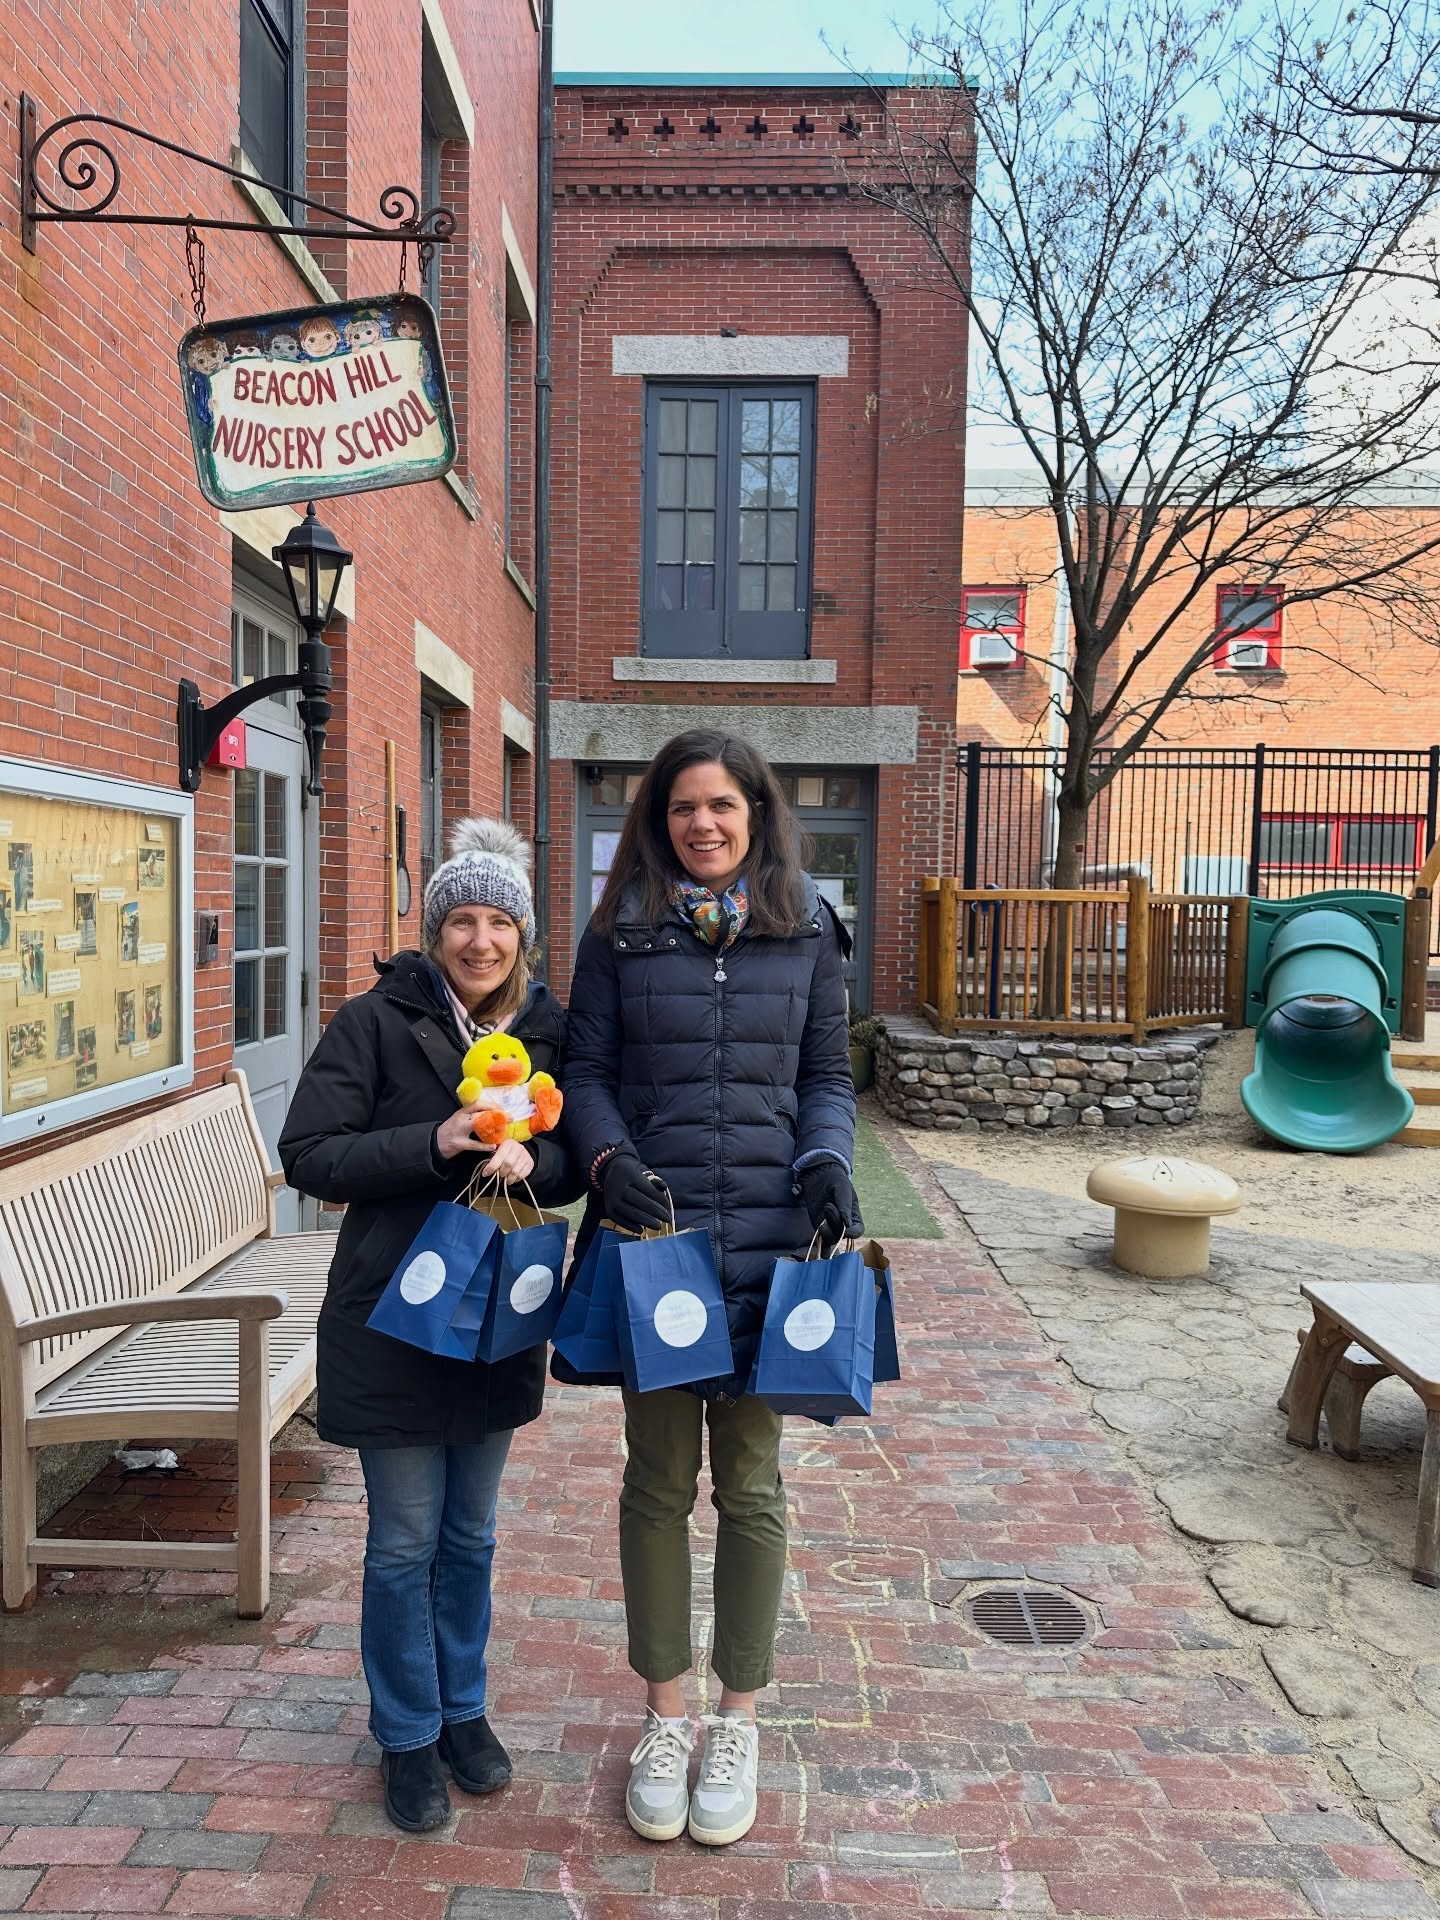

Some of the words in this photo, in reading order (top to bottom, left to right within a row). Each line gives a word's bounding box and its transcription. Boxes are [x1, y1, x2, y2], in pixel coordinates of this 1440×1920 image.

[234, 367, 337, 407] BEACON
[343, 351, 402, 398] HILL
[212, 415, 326, 469] NURSERY
[336, 390, 437, 465] SCHOOL
